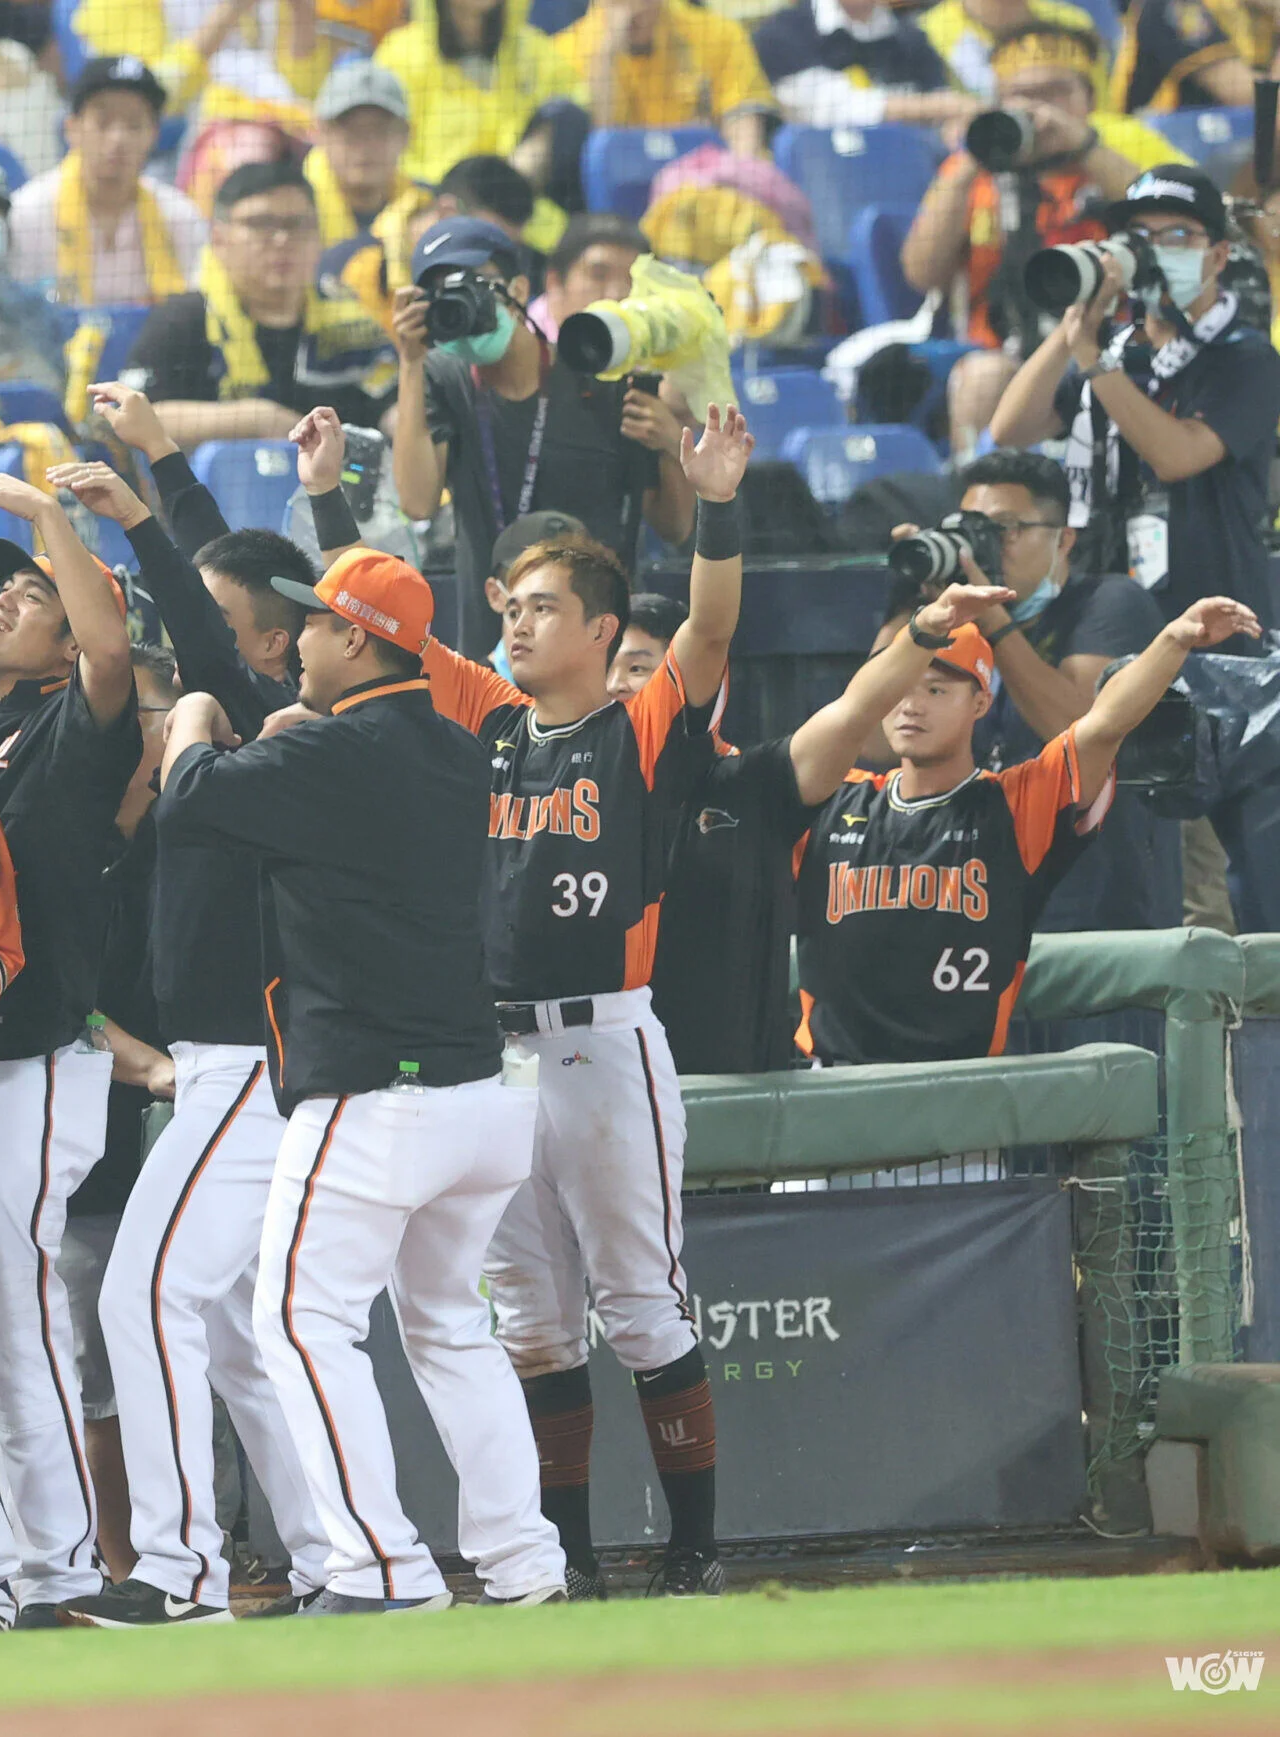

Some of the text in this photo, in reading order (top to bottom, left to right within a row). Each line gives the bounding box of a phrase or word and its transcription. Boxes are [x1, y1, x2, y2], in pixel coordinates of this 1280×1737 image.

[551, 871, 609, 918] 39
[826, 857, 990, 925] UNILIONS
[932, 947, 991, 992] 62
